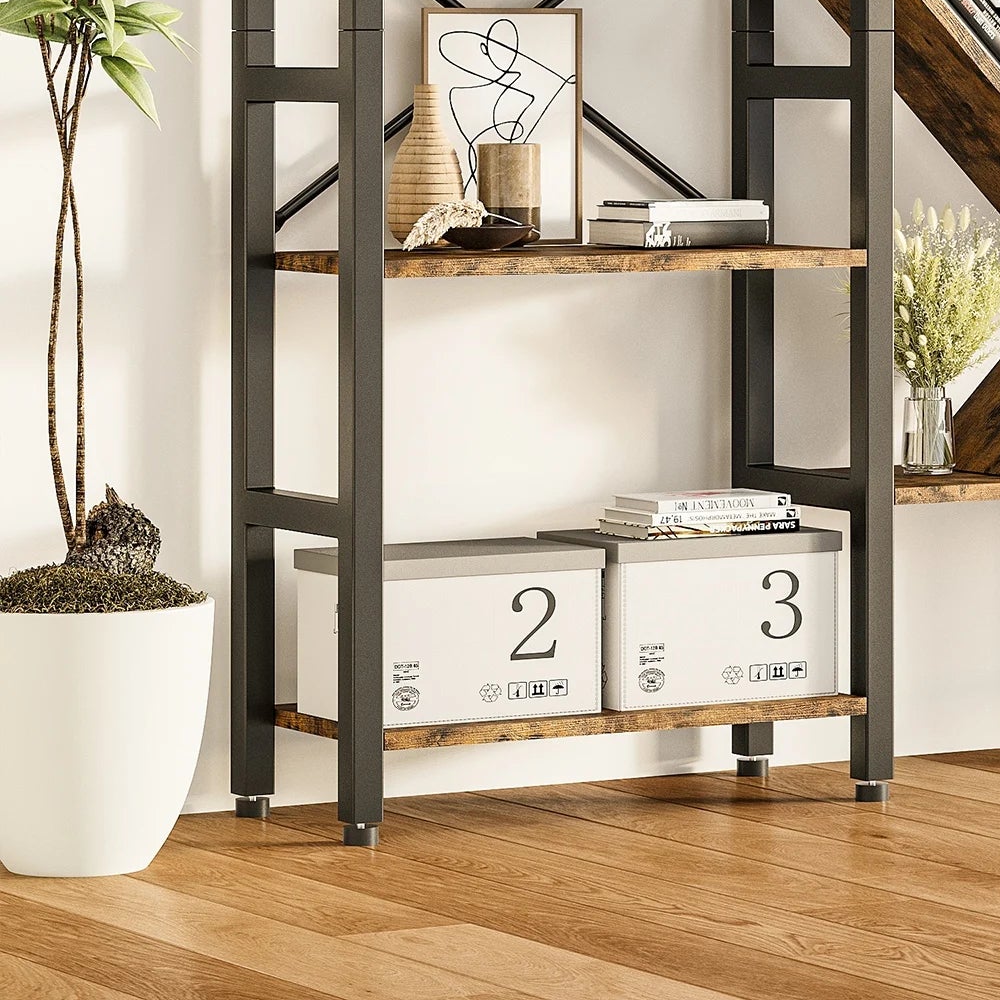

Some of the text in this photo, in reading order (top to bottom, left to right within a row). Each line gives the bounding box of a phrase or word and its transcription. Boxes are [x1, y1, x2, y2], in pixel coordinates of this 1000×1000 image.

[772, 519, 796, 530] SARA
[510, 586, 557, 661] 2
[760, 569, 803, 640] 3
